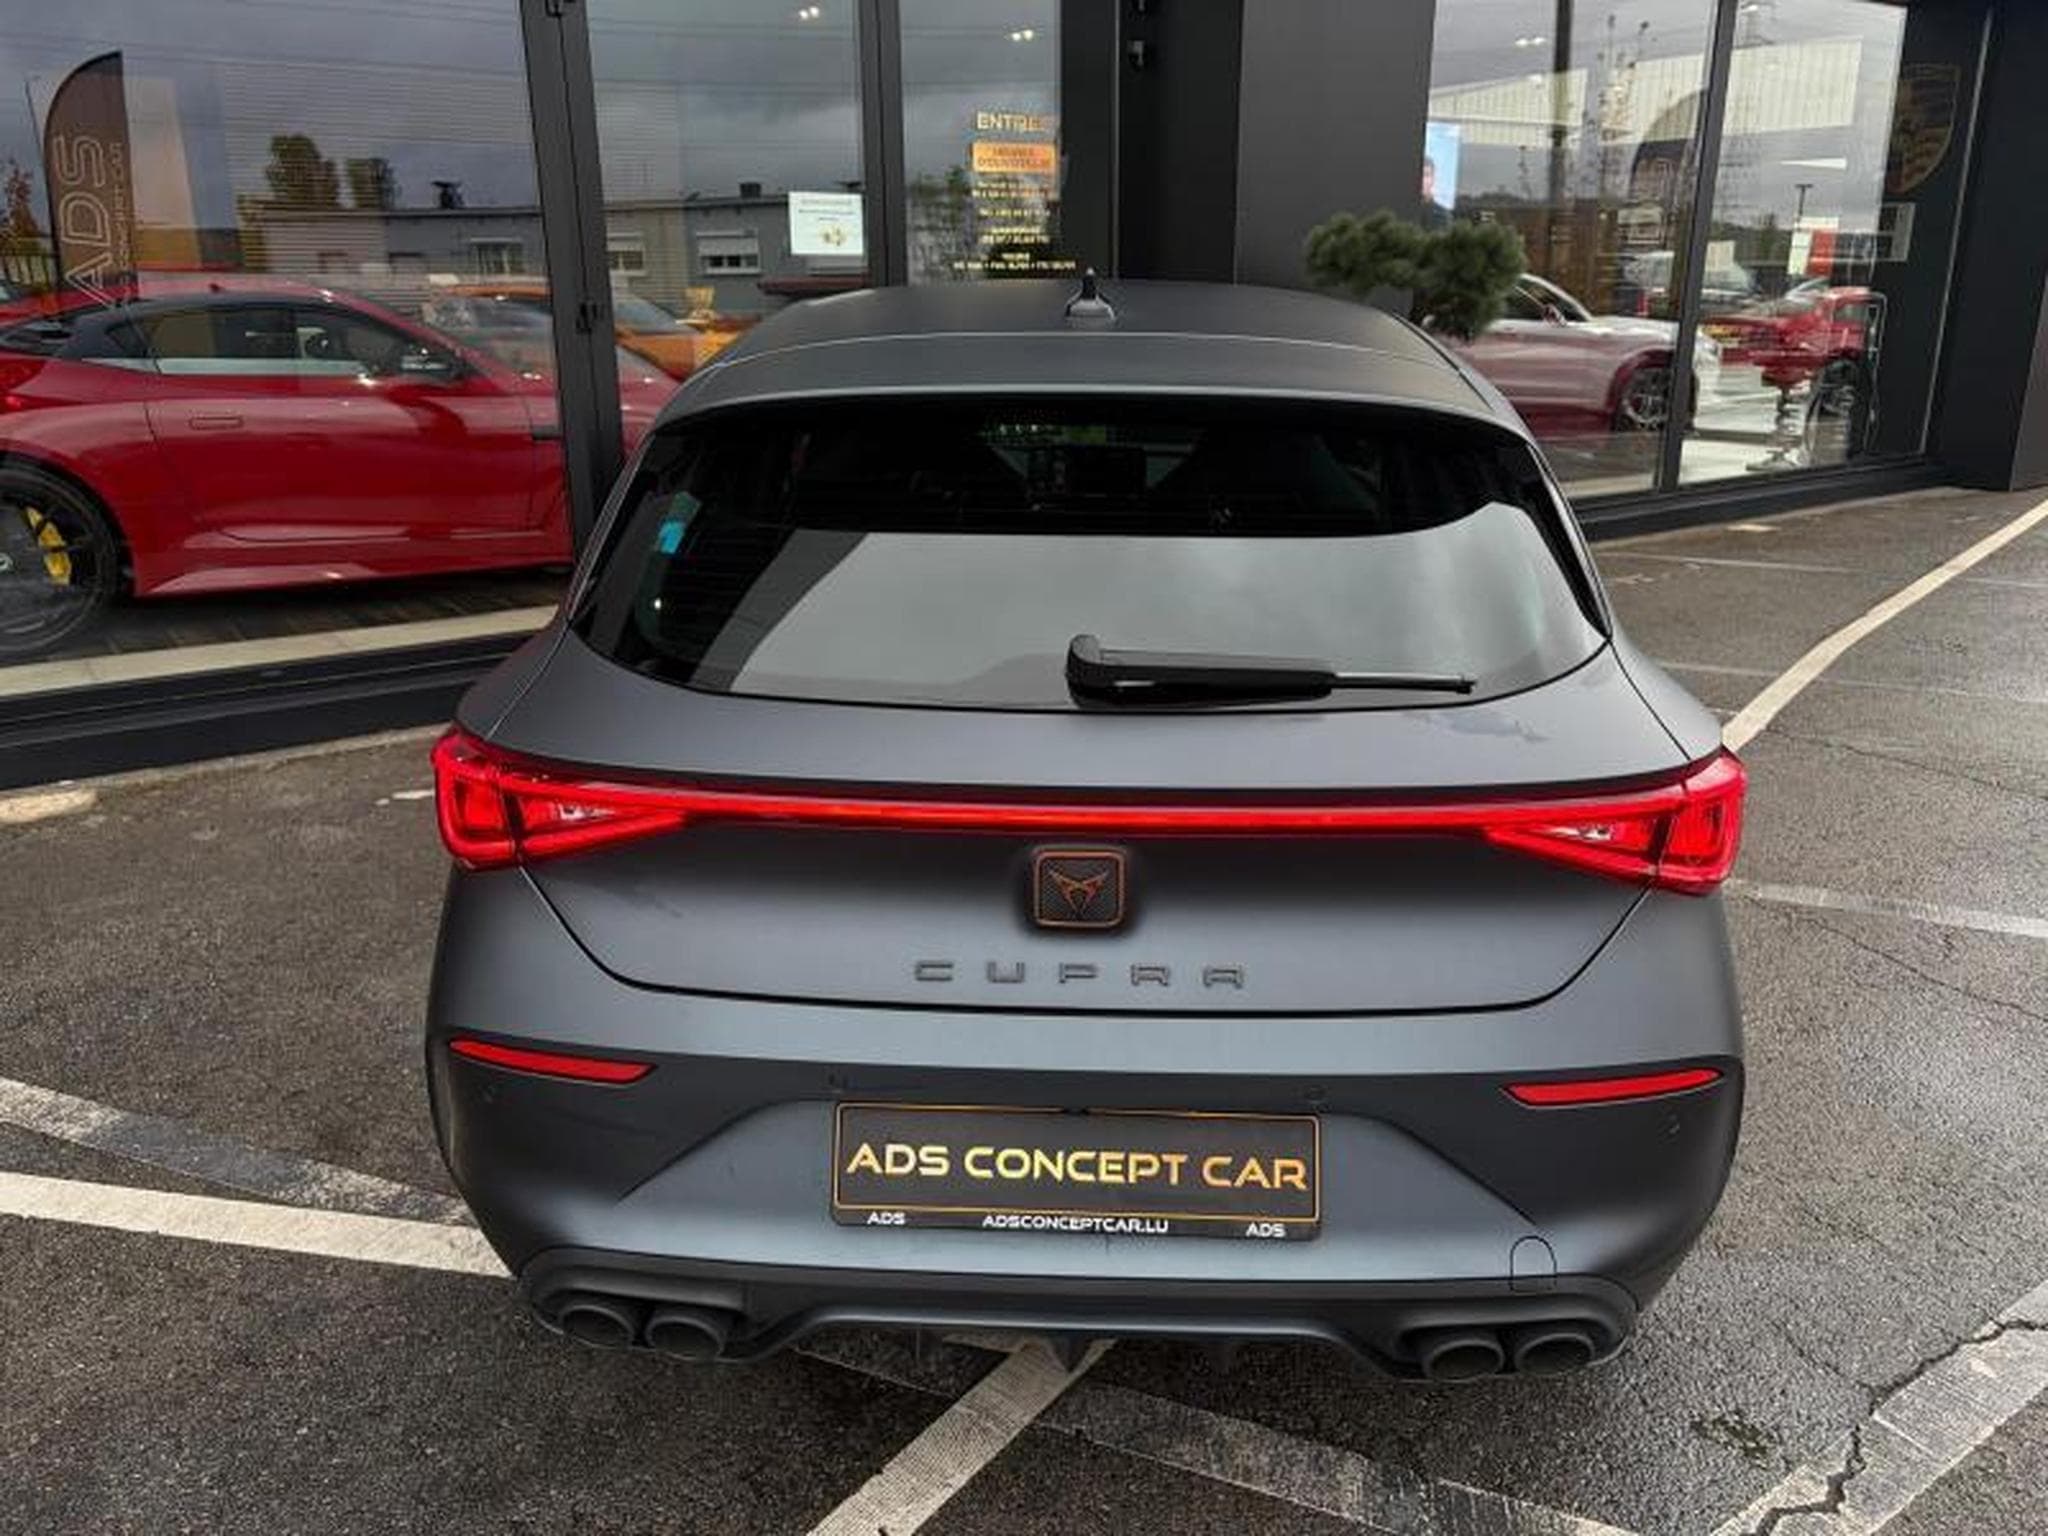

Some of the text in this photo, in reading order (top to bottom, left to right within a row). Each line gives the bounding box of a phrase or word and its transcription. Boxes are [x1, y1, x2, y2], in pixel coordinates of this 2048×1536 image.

[53, 135, 116, 310] ADS
[914, 960, 1244, 988] CUPRA
[846, 1142, 1307, 1190] ADS CONCEPT CAR
[866, 1211, 1286, 1238] ADS ADSCONCEPTCAR.LU ADS
